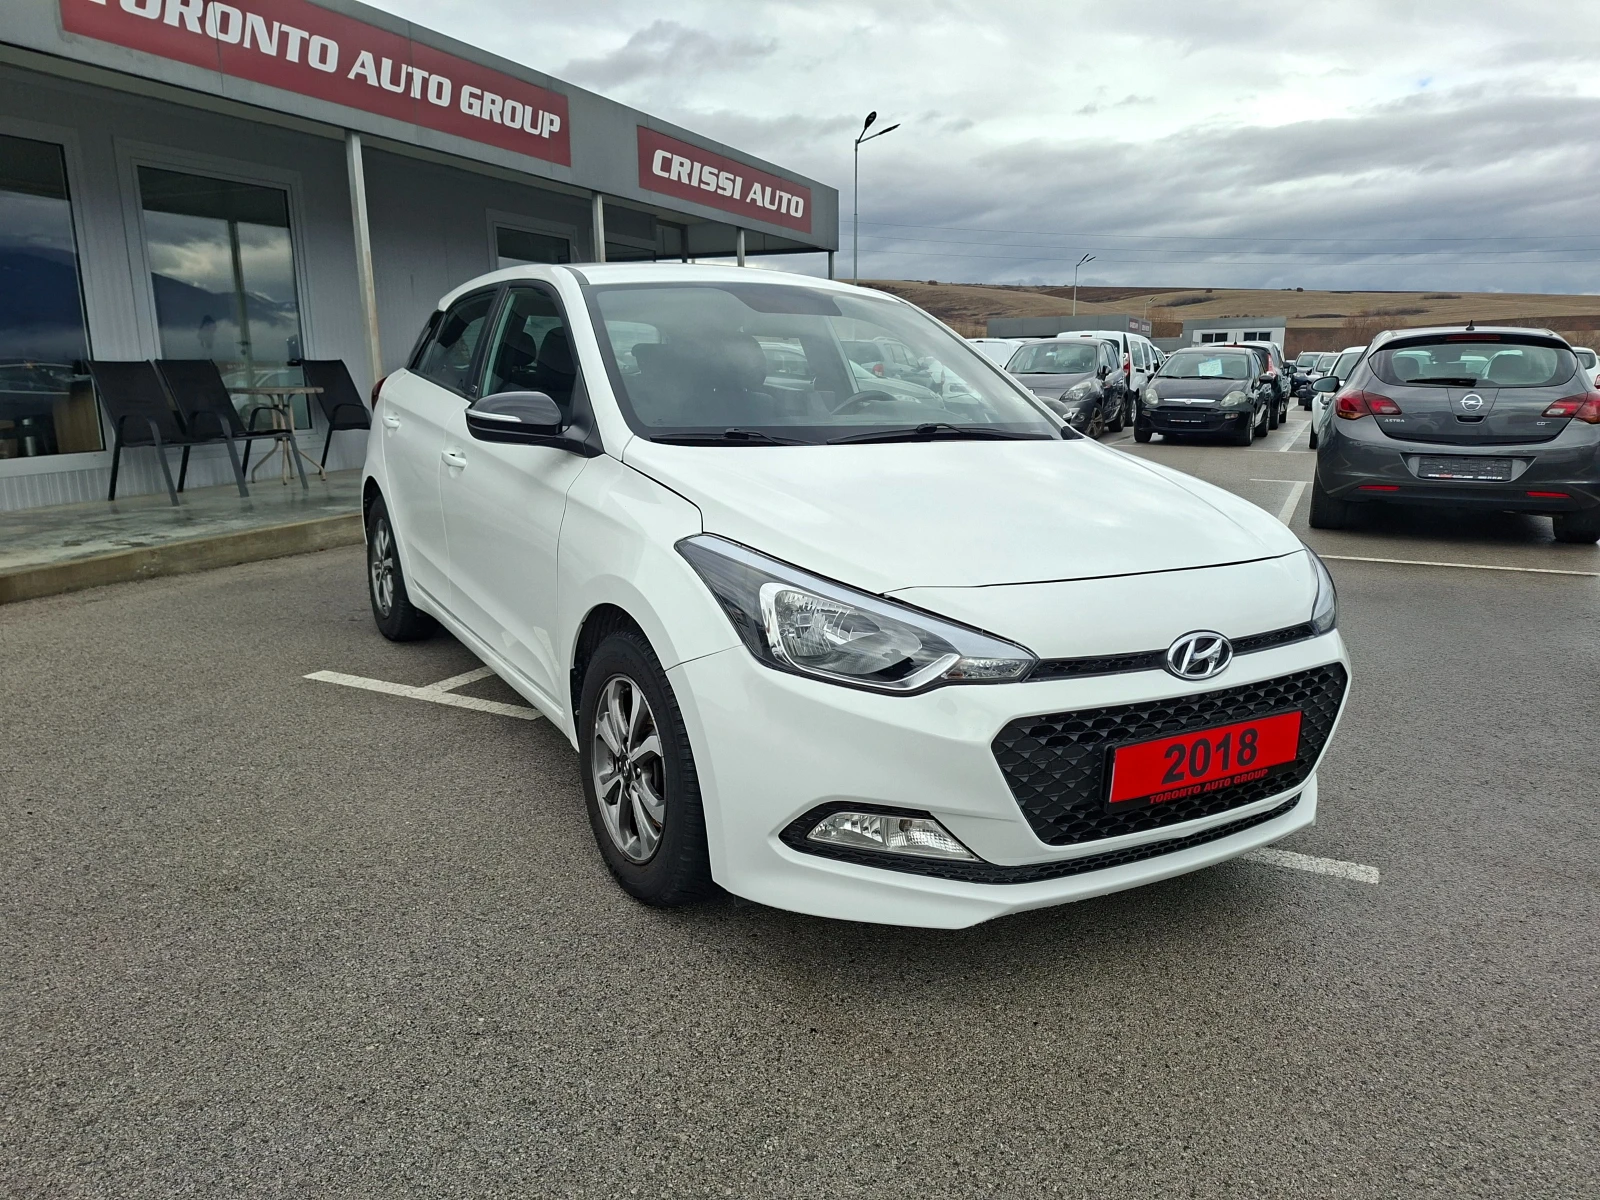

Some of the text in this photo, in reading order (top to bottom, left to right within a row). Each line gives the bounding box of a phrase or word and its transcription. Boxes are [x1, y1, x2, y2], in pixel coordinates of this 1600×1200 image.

[89, 0, 561, 139] RONTO AUTO GROUP
[652, 149, 805, 218] CRISSI AUTO
[1149, 768, 1269, 804] TORONTO AUTO GROUP
[1161, 728, 1259, 785] 2018
